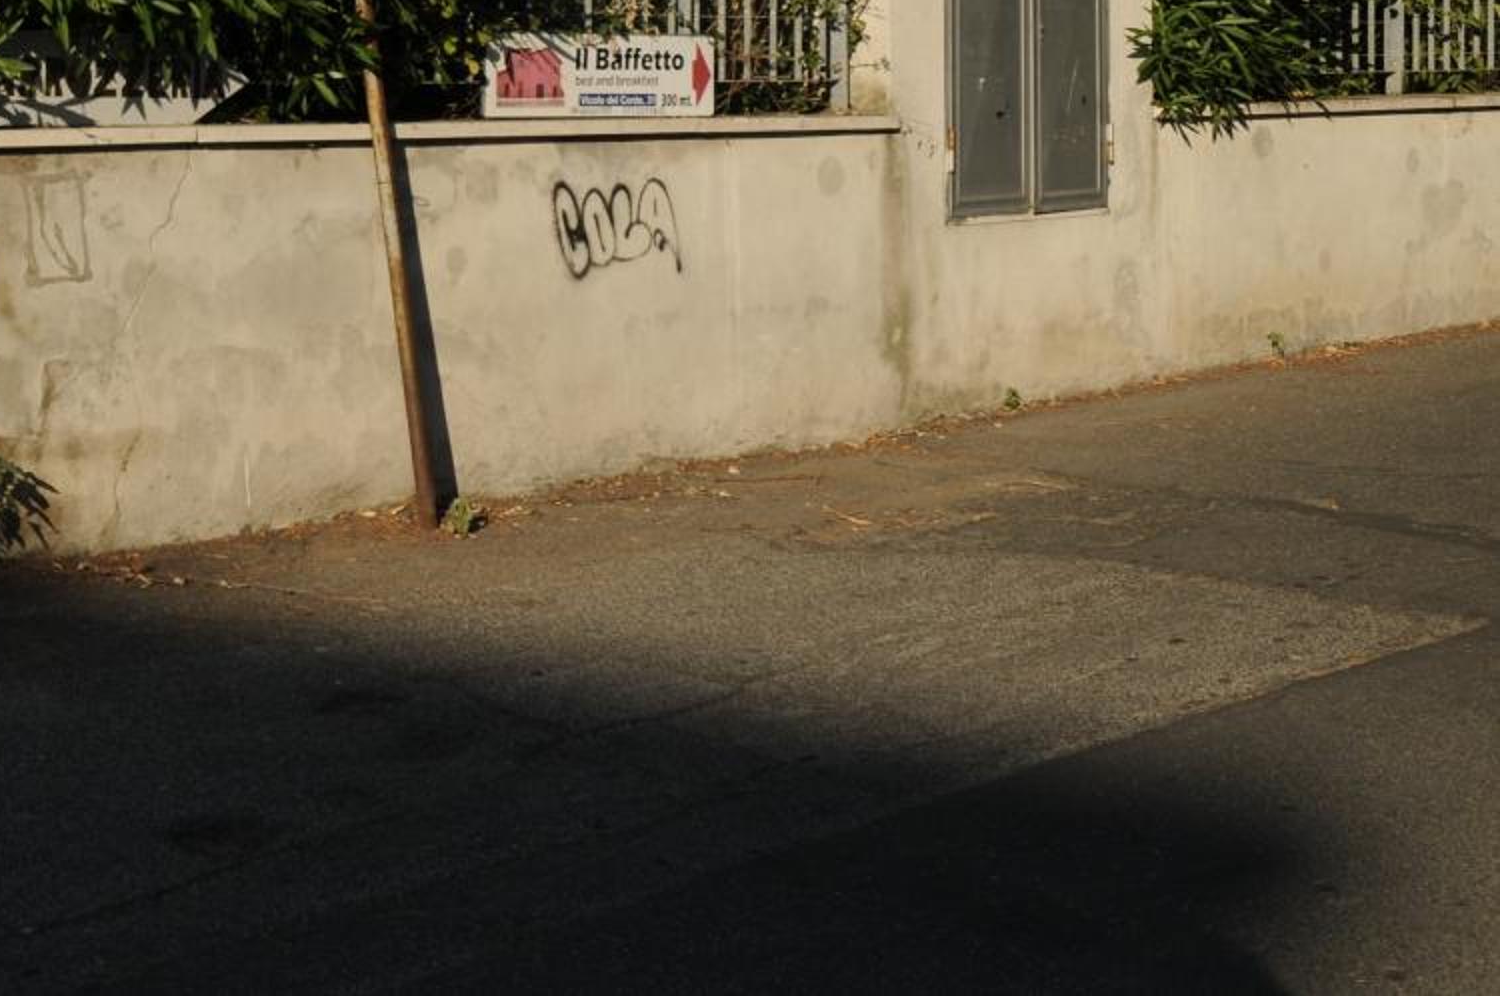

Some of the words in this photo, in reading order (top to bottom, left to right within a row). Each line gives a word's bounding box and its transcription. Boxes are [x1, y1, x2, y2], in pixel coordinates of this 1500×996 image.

[576, 47, 588, 71] Il
[596, 47, 685, 71] Baffetto
[575, 75, 593, 87] bed
[596, 75, 614, 87] and
[616, 75, 659, 87] breakfast
